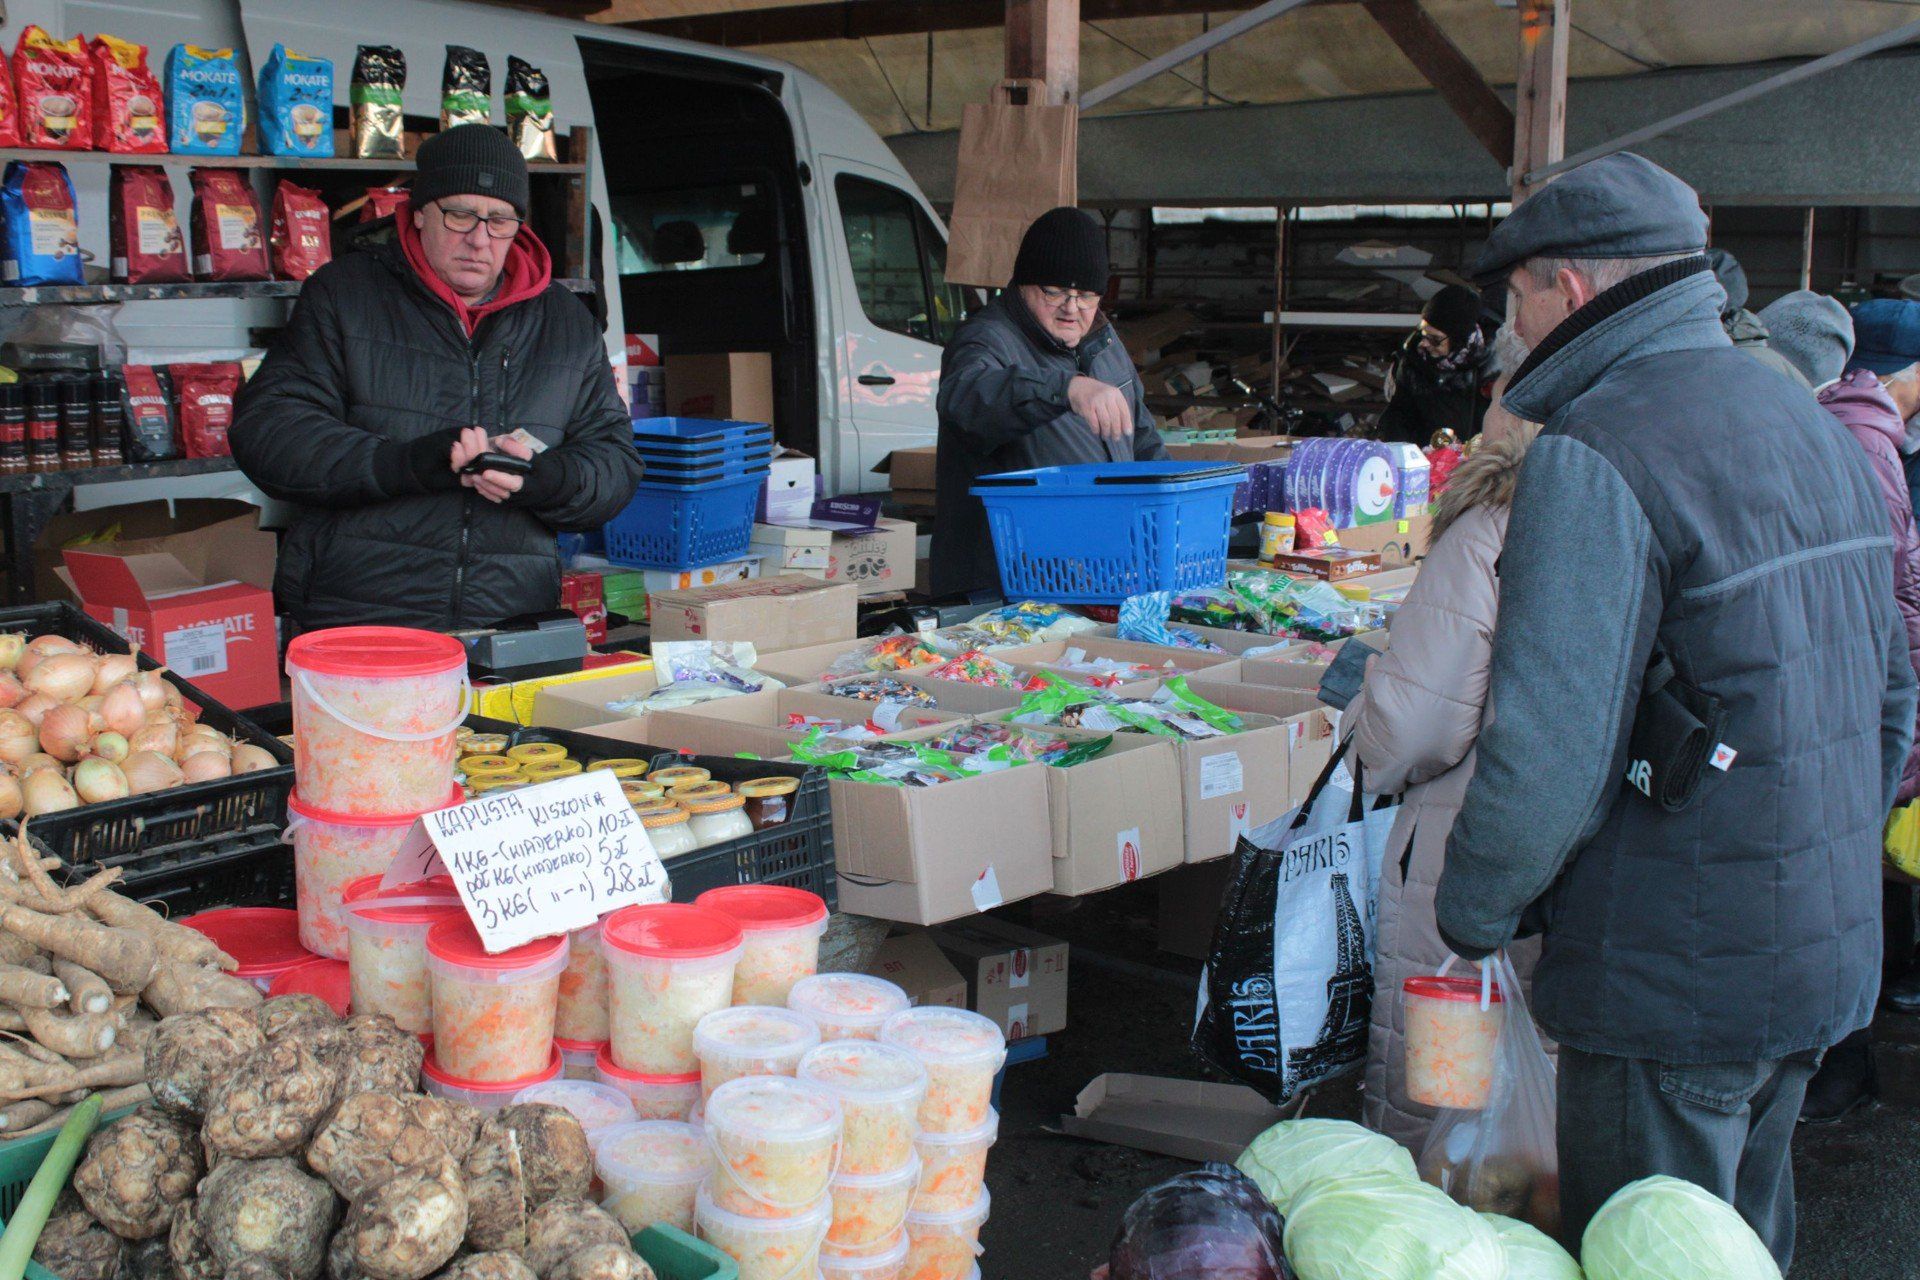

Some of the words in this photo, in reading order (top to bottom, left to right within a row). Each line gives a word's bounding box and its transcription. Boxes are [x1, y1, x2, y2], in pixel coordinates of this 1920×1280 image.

[180, 69, 236, 85] MOKATE
[284, 73, 330, 88] MOKATE
[1284, 832, 1350, 882] PARIS
[476, 899, 499, 930] 3
[1232, 975, 1278, 1074] PARIS
